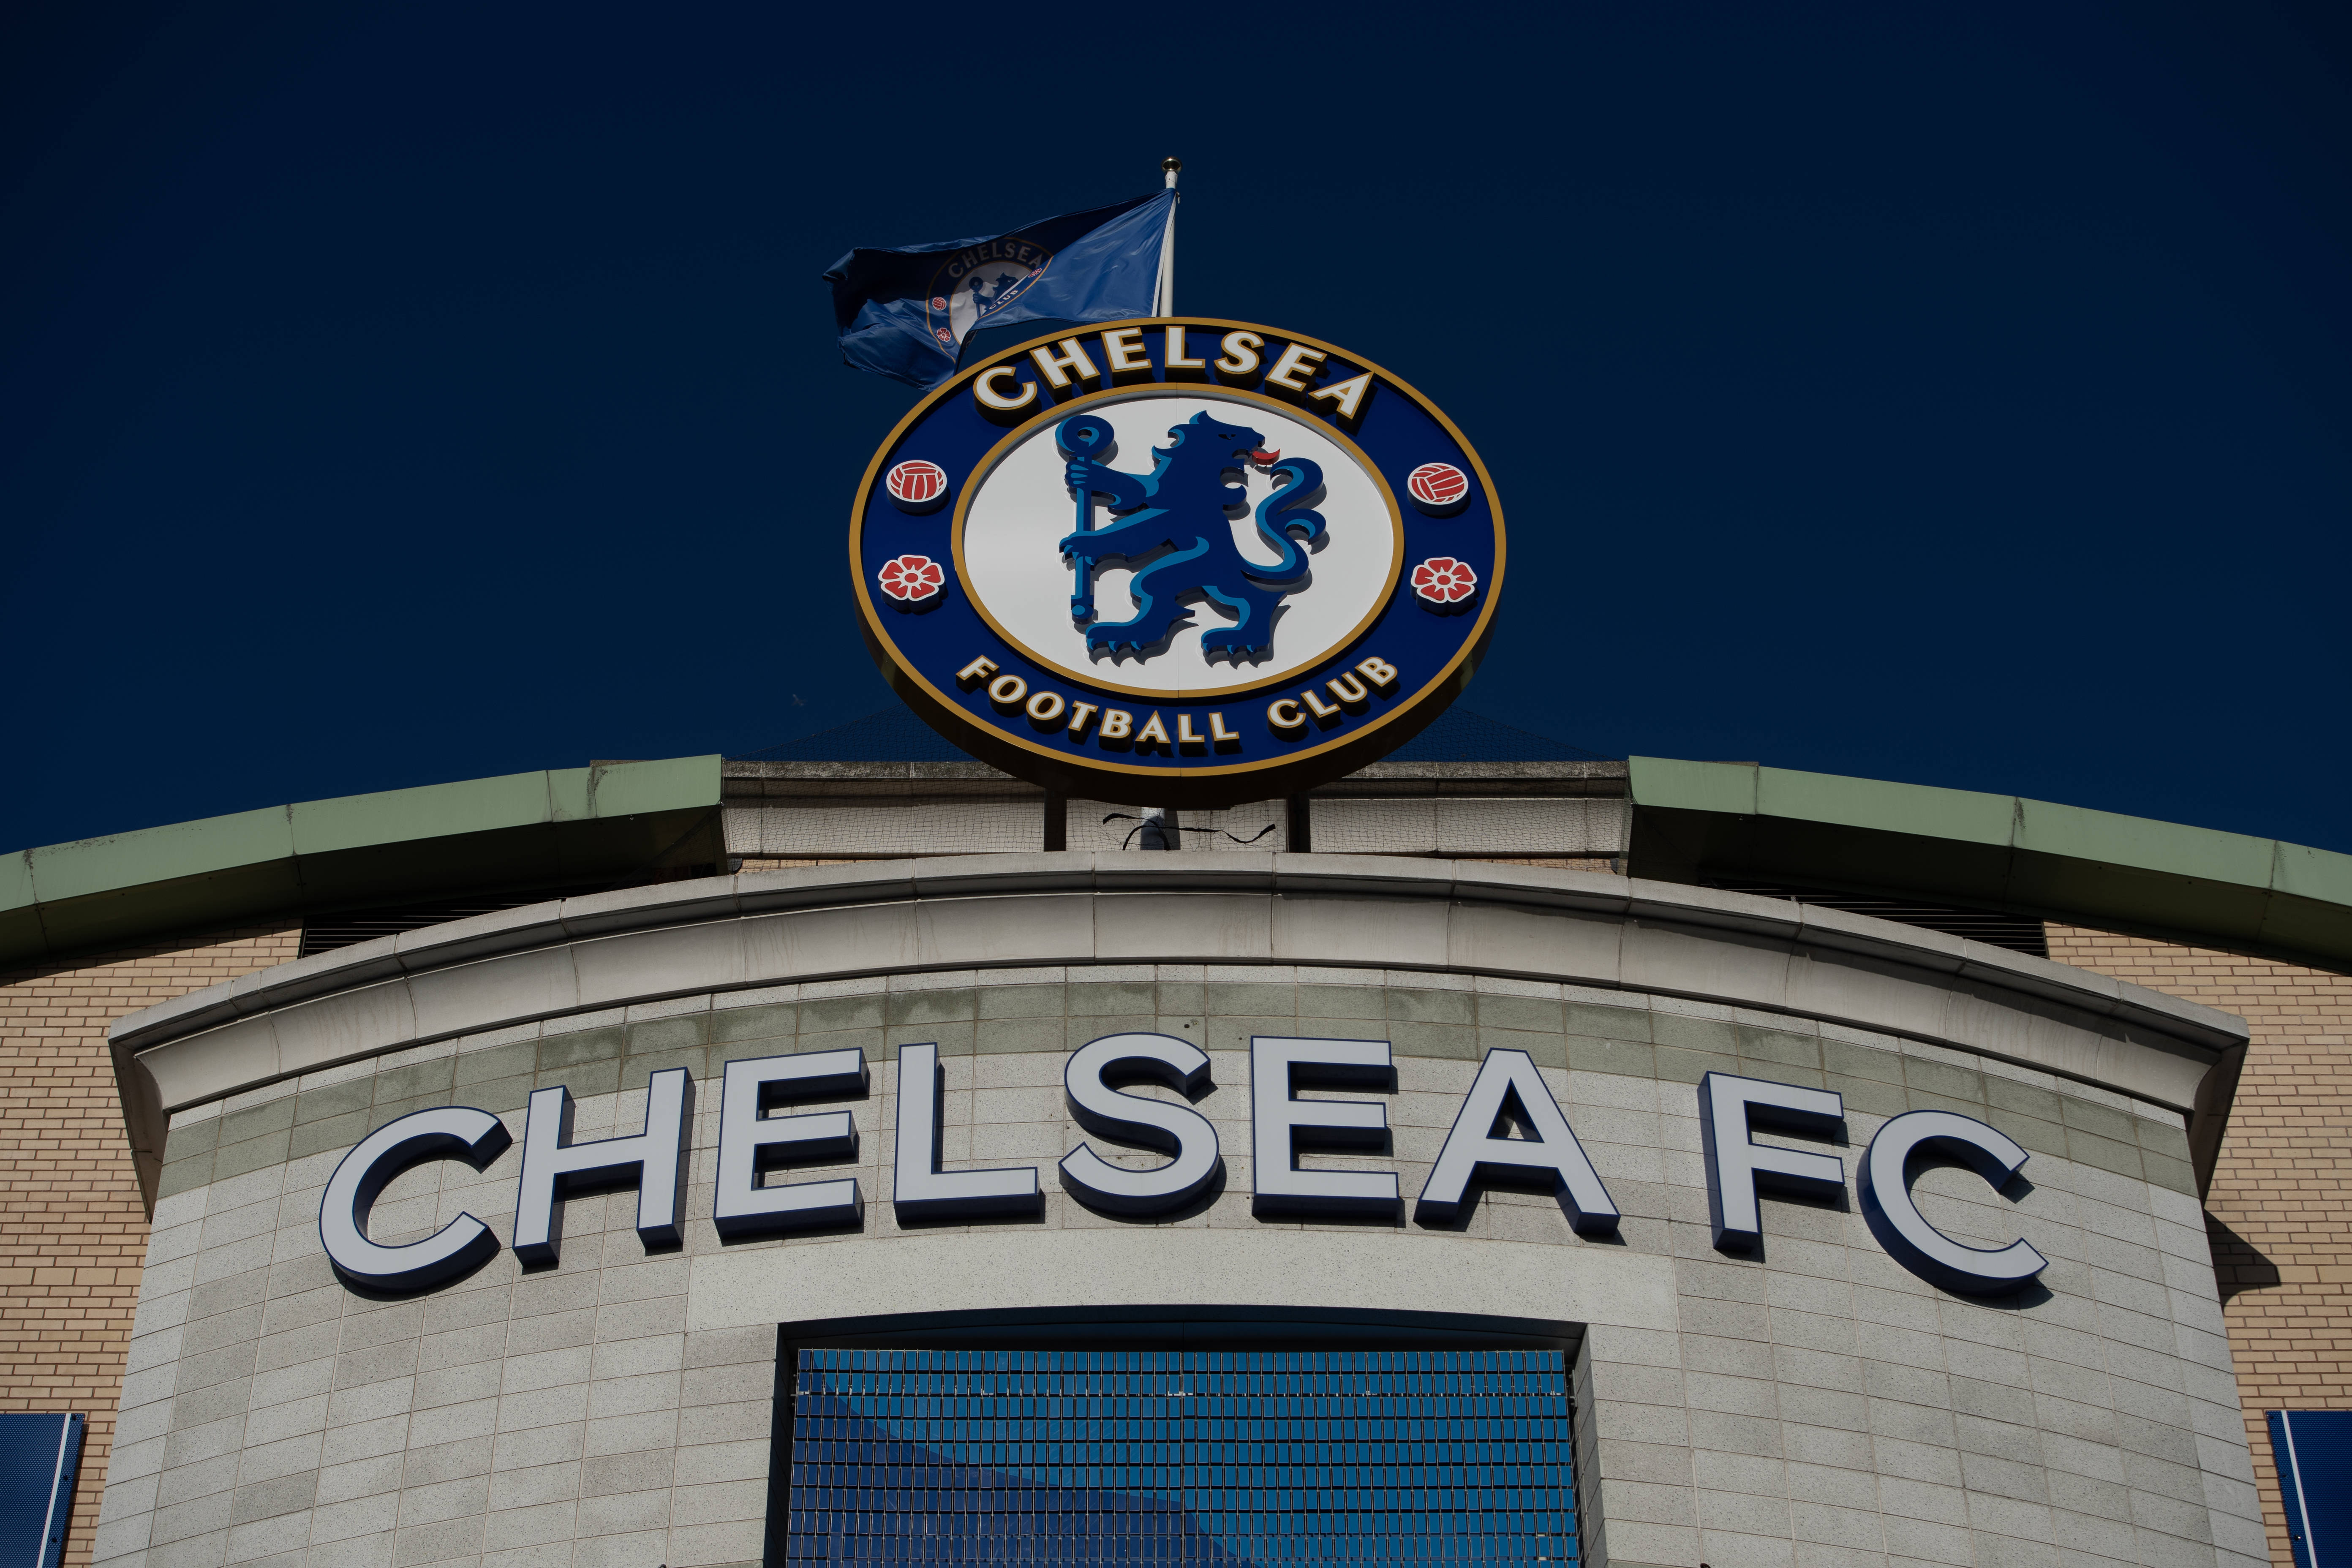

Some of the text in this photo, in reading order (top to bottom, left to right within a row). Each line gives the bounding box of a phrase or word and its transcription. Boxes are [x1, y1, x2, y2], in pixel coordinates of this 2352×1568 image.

[948, 242, 1043, 278] CHELSEA
[989, 290, 1018, 309] CLUB
[973, 325, 1375, 420] CHELSEA
[956, 655, 1398, 745] FOOTBALL CLUB
[318, 1032, 2049, 1298] CHELSEA FC
